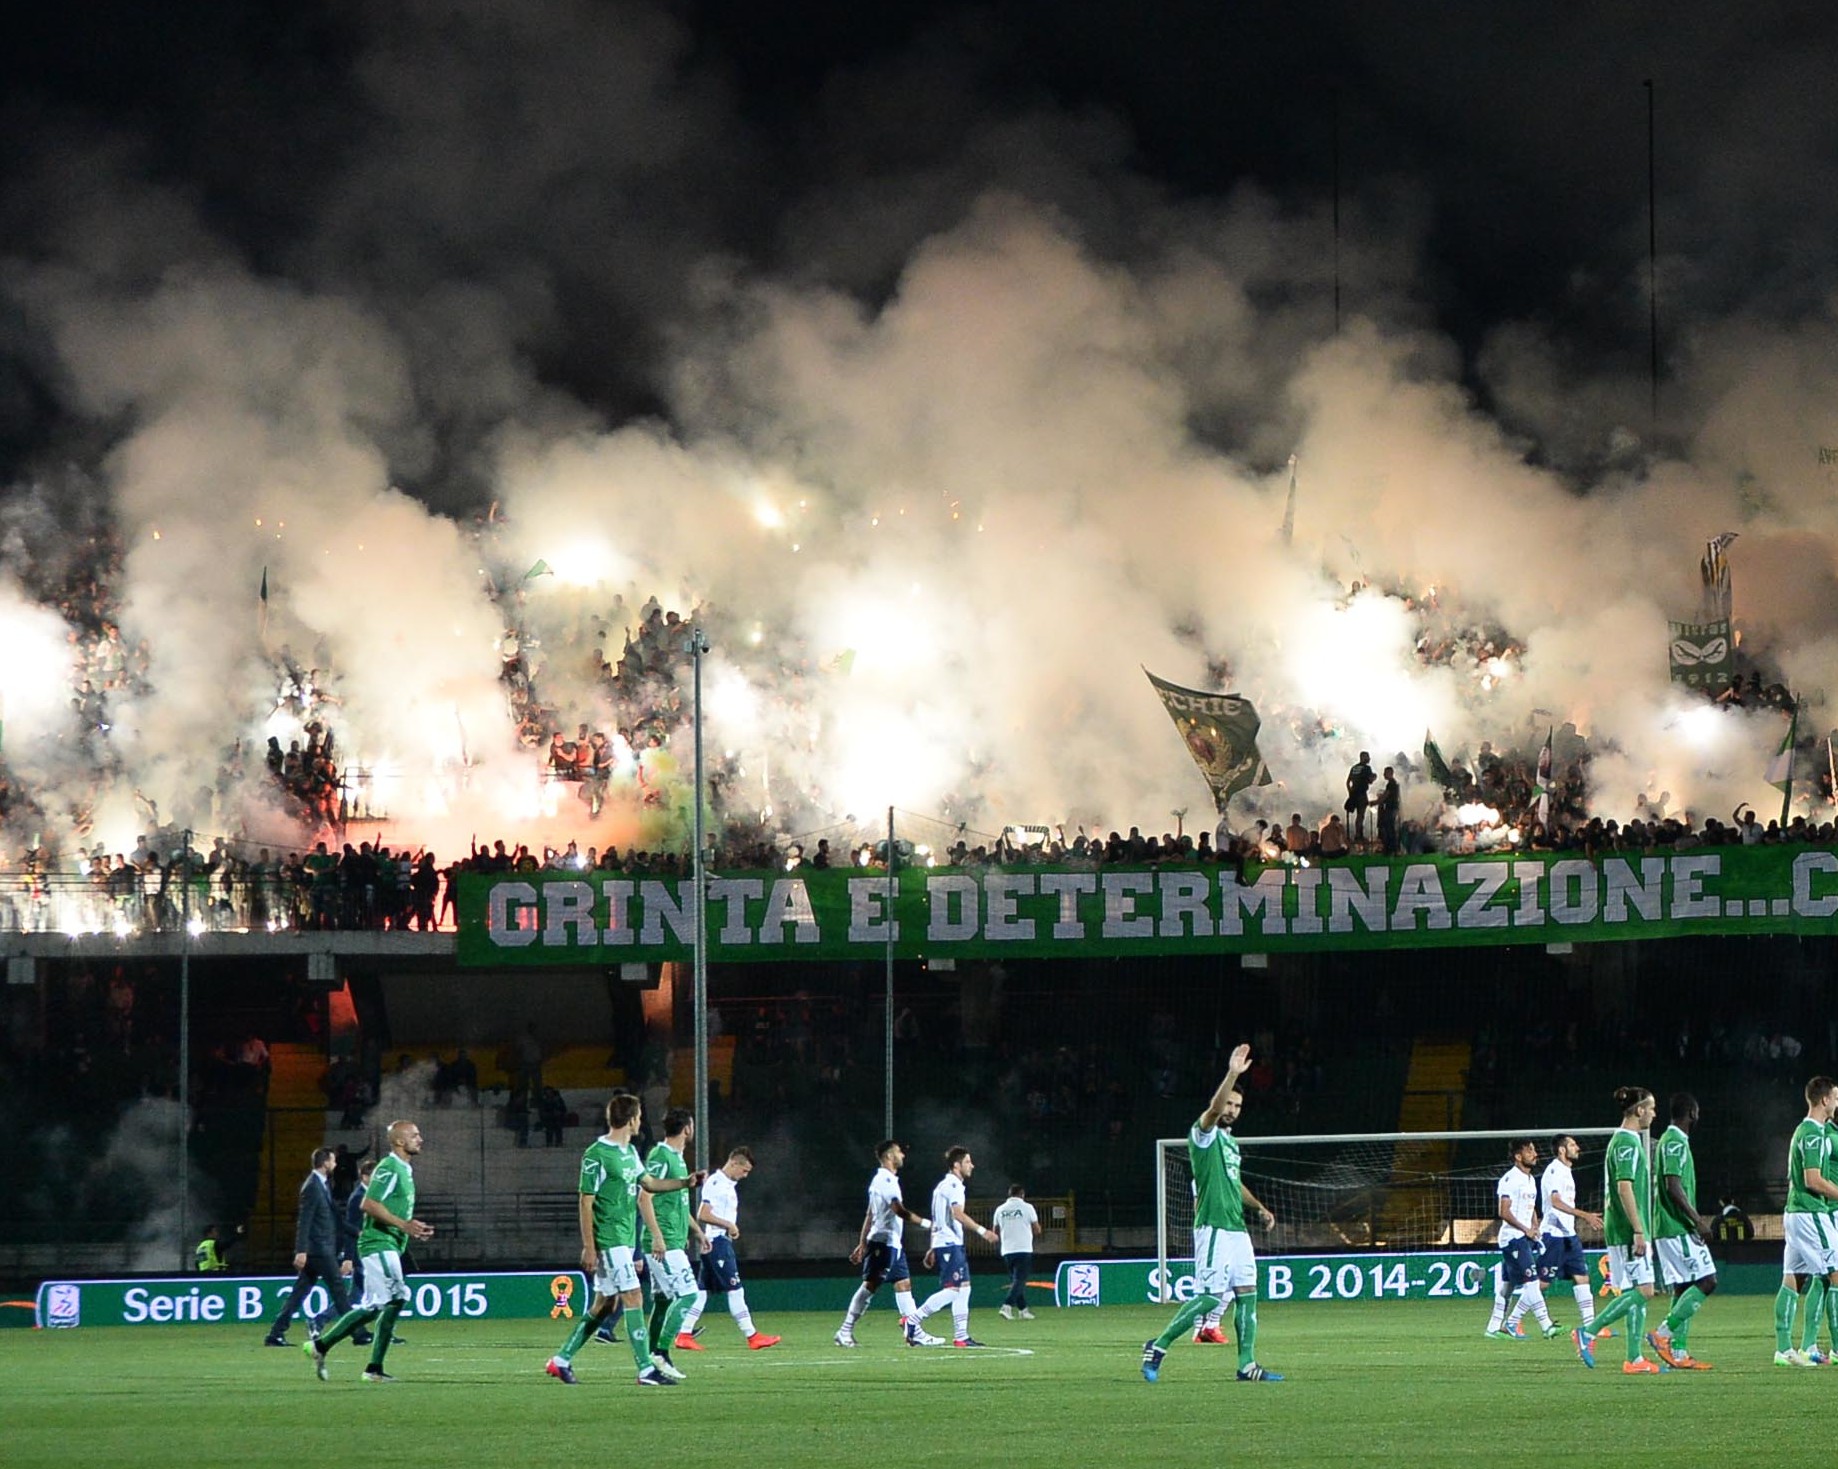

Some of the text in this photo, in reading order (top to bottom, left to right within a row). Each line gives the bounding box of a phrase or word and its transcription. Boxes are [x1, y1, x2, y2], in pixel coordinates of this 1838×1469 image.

[488, 878, 821, 947] GRINTA
[847, 876, 900, 944] E
[1267, 1261, 1523, 1300] B 2014-201
[123, 1286, 226, 1323] Serie
[237, 1285, 264, 1320] B
